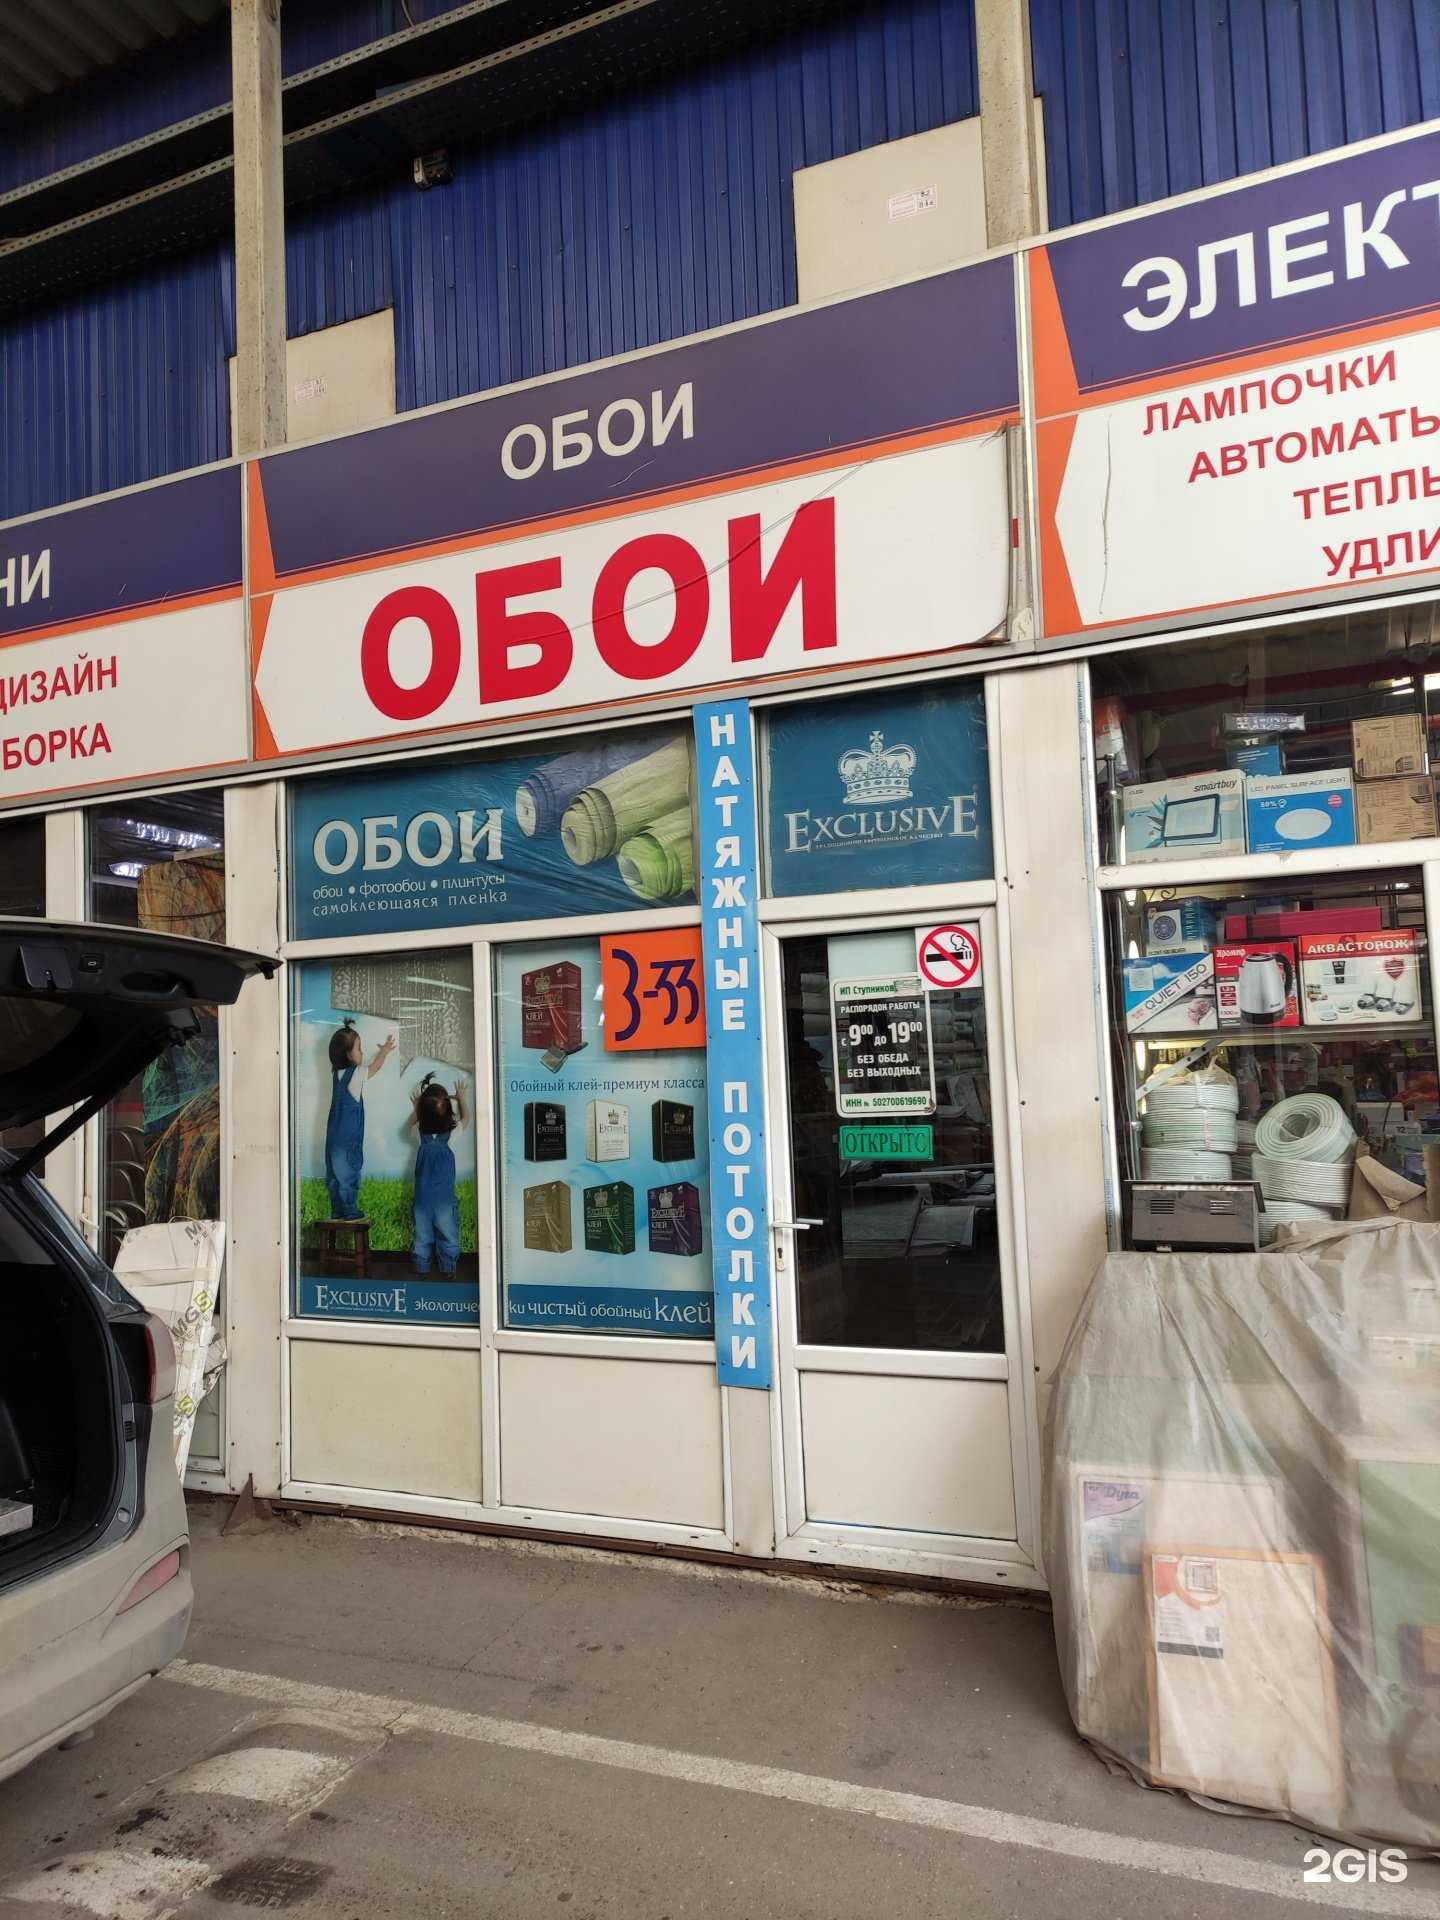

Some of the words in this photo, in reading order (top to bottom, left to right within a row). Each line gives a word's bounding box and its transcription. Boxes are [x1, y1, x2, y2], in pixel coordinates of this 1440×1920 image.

[1143, 351, 1397, 436] ЛАМПОЧКИ
[500, 382, 694, 480] ОБОИ
[360, 496, 837, 721] ОБОИ
[3, 722, 112, 770] БОРКА
[313, 808, 504, 875] ОБОИ
[709, 713, 749, 1031] НАТЯЖНЫЕ
[313, 885, 343, 900] обои
[360, 879, 426, 898] фотообои
[442, 873, 505, 891] плинтусы
[313, 896, 438, 917] самоклеющаяся
[448, 890, 507, 906] пленка
[1307, 939, 1409, 954] АКВАСТОРОЖ
[612, 948, 700, 1041] 3-33
[840, 986, 851, 995] ИП
[1145, 979, 1181, 1010] QUIET
[840, 1003, 887, 1014] РАСПОРЯДОК
[889, 1001, 920, 1011] РАБОТЫ
[847, 1068, 864, 1078] БЕЗ
[867, 1066, 921, 1077] ВЫХОДНЫХ
[857, 1054, 874, 1064] БЕЗ
[878, 1053, 909, 1063] ОБЕДА
[510, 1077, 564, 1093] Обойный
[568, 1077, 660, 1094] клей-премиум
[663, 1077, 705, 1089] класса
[846, 1098, 862, 1108] ИНН
[845, 1132, 929, 1153] ОТКРЫТО
[722, 1081, 757, 1370] ПОТОЛКИ
[414, 1297, 480, 1313] экологиче
[527, 1300, 586, 1317] чистый
[590, 1303, 651, 1320] обойный
[654, 1296, 712, 1324] клей
